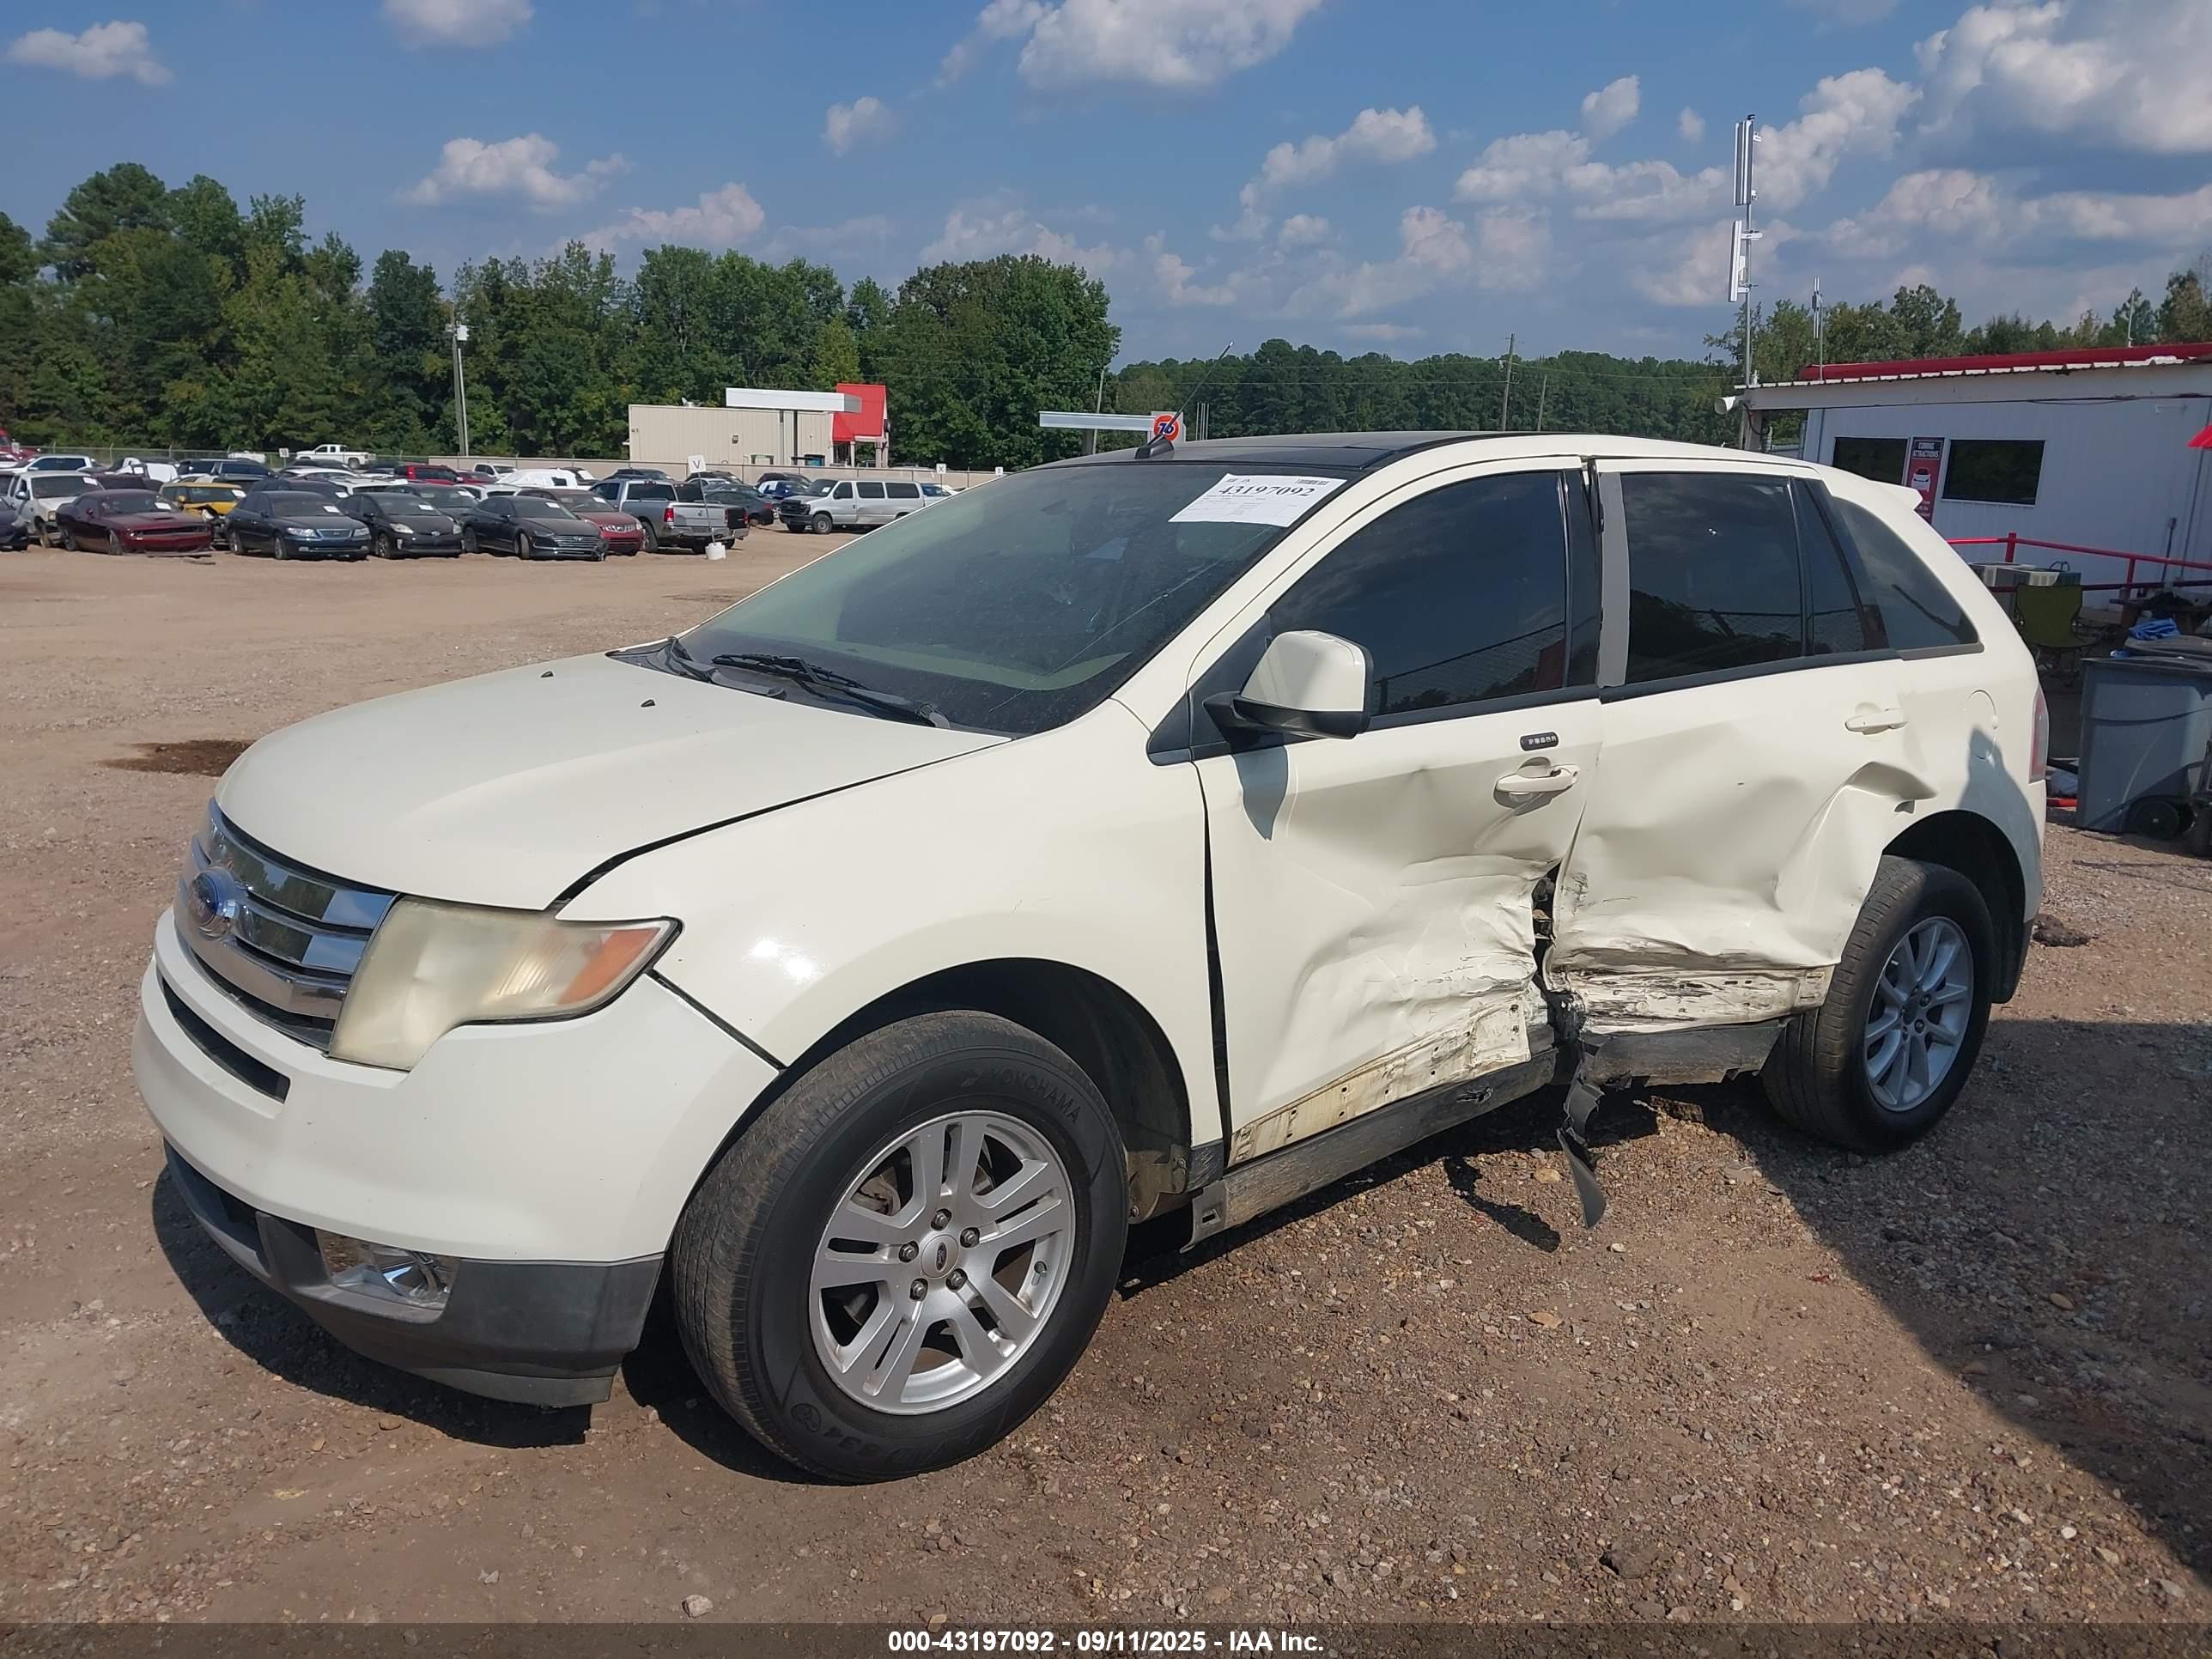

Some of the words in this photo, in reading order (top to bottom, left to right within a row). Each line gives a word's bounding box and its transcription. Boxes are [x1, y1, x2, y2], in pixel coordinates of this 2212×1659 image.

[692, 460, 701, 469] V
[1219, 485, 1316, 496] 43197092
[991, 1067, 1082, 1124] YOKOHAMA
